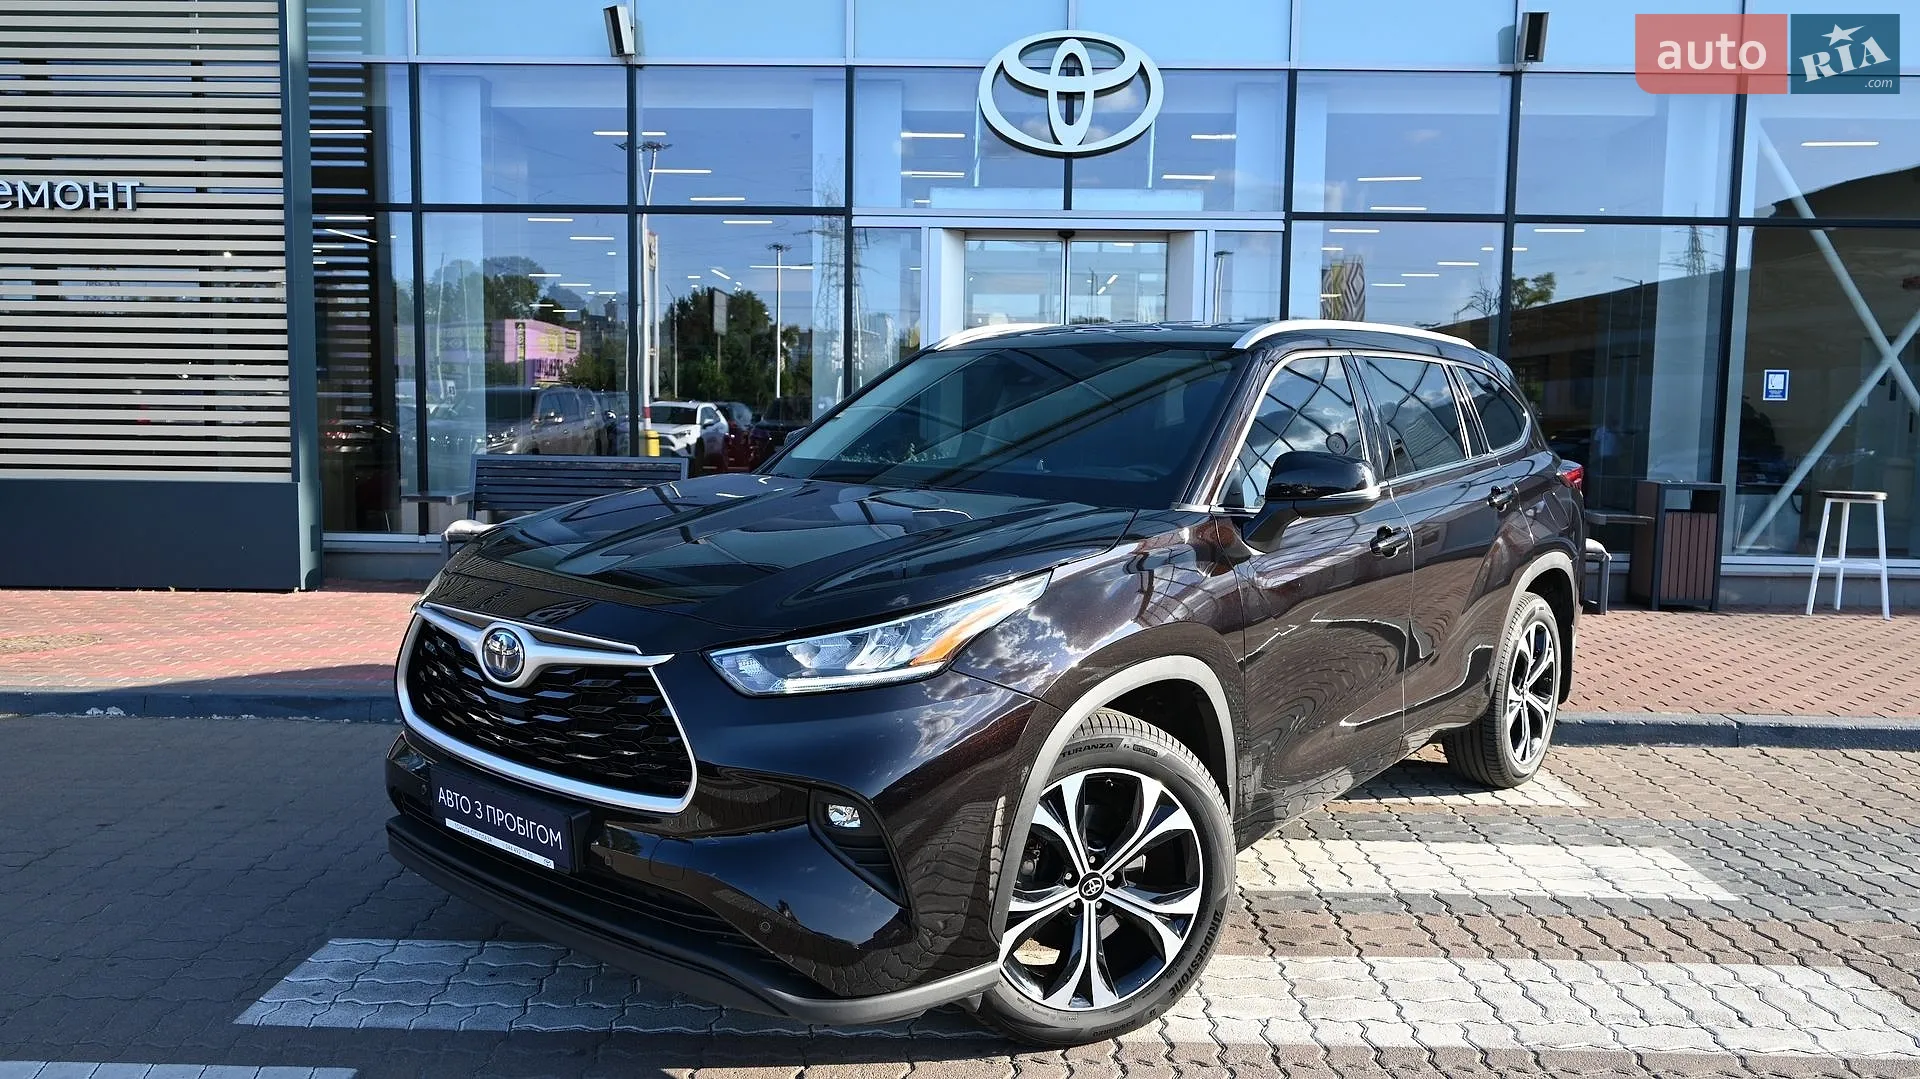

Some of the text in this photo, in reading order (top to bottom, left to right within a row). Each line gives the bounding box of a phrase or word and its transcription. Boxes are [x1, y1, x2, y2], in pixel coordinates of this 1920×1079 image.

[1061, 742, 1114, 758] TURANZA
[438, 786, 471, 814] АВТО
[486, 804, 563, 850] ПРОБІГОМ
[1168, 910, 1223, 999] BRIDGESTONE
